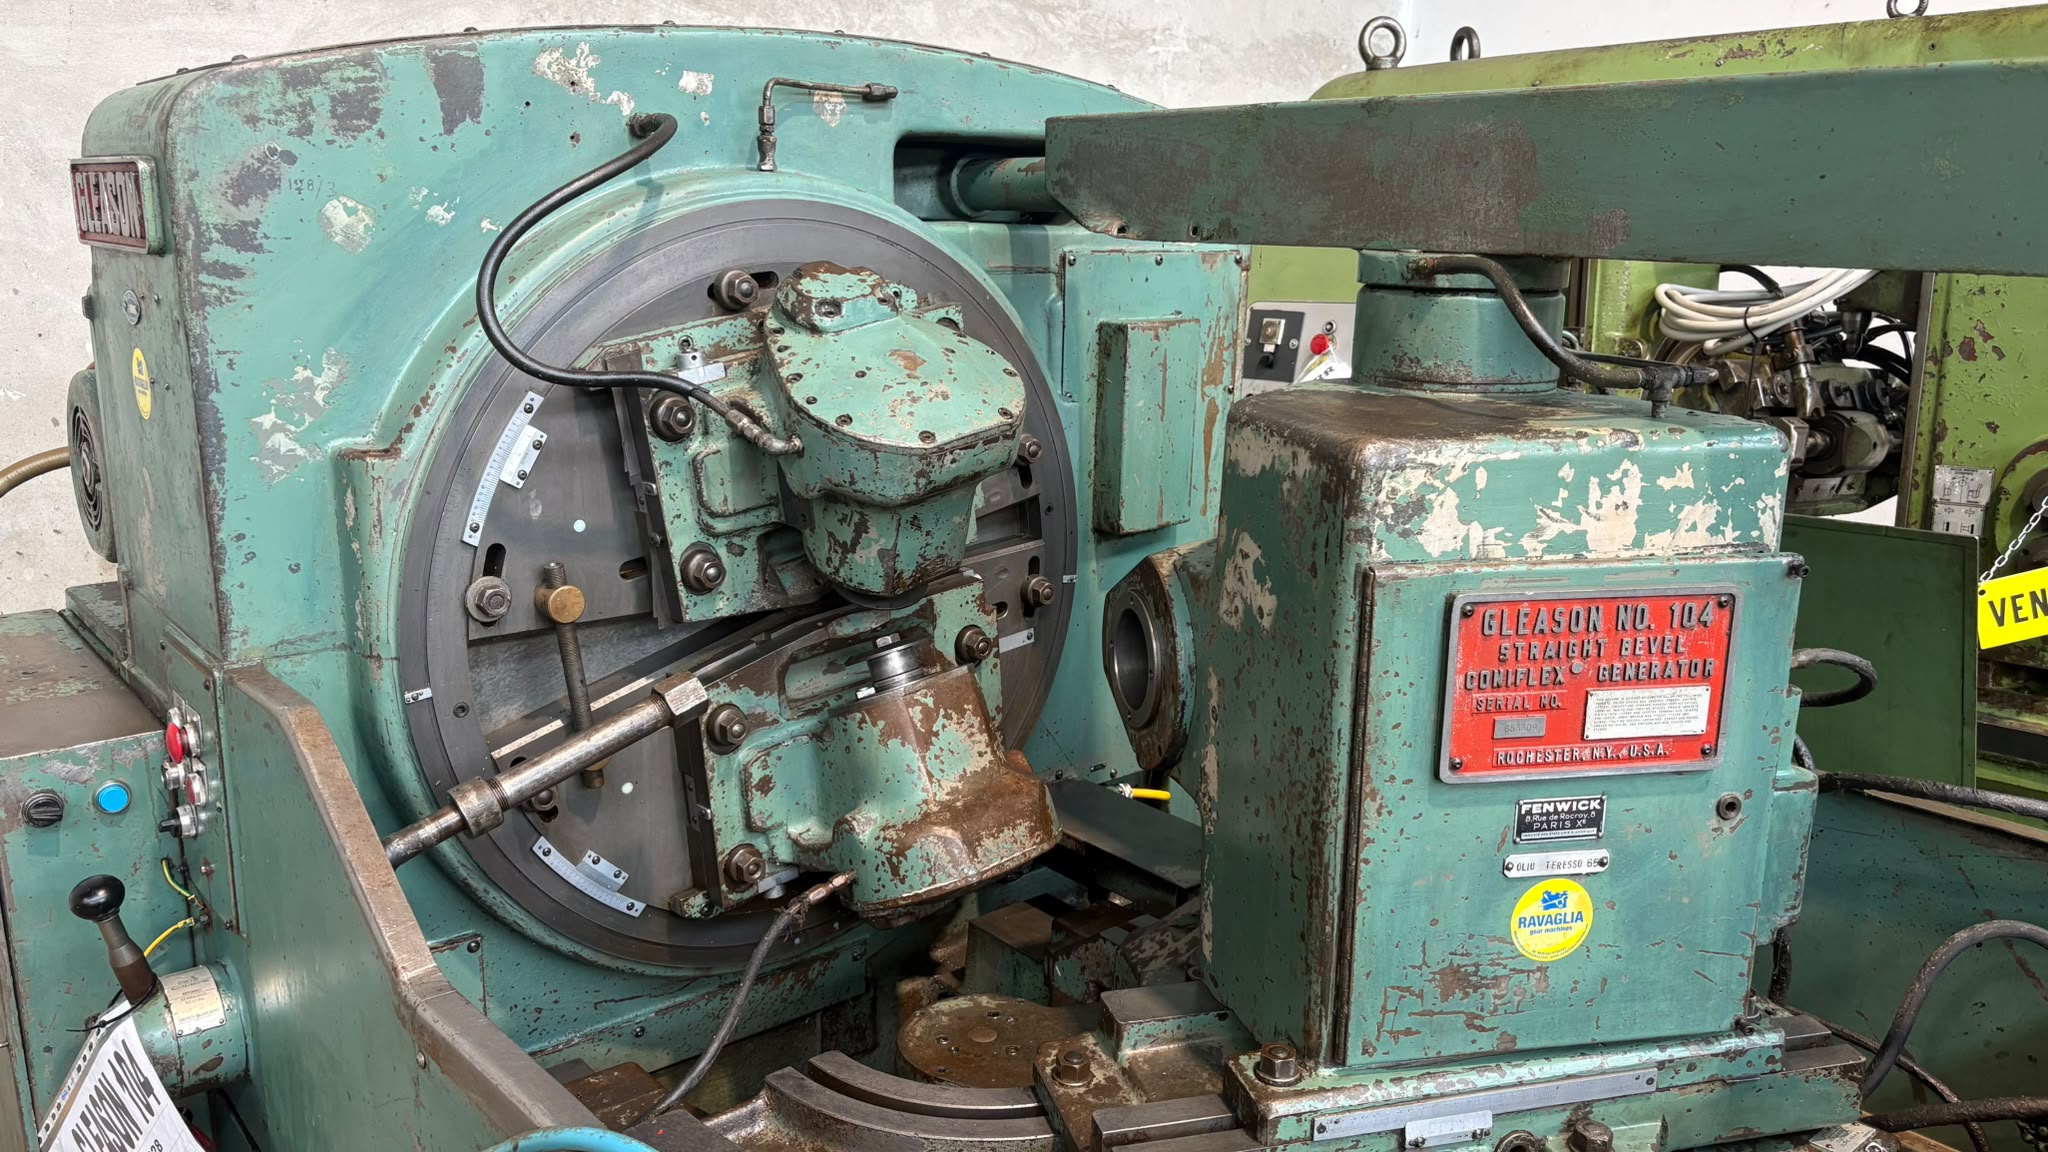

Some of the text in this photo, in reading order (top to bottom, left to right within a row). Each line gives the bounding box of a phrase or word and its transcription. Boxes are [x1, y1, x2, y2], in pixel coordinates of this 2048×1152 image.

[75, 171, 141, 238] GLEASON
[1988, 588, 2048, 628] VEN
[1482, 601, 1714, 636] GLEASON NO. 104
[1499, 635, 1686, 662] STRAIGHT BEVEL
[1465, 658, 1715, 690] CONIFLEX GENERATOR
[1476, 694, 1562, 711] SERIAL NO.
[1630, 743, 1669, 758] U.S.A.
[1521, 799, 1602, 815] FENWICK
[1533, 820, 1571, 831] PARIS
[1545, 859, 1583, 870] TERESSO
[1586, 858, 1600, 868] 65
[1518, 911, 1584, 929] RAVAGLIA
[1544, 925, 1573, 933] machines
[107, 1038, 161, 1124] 104
